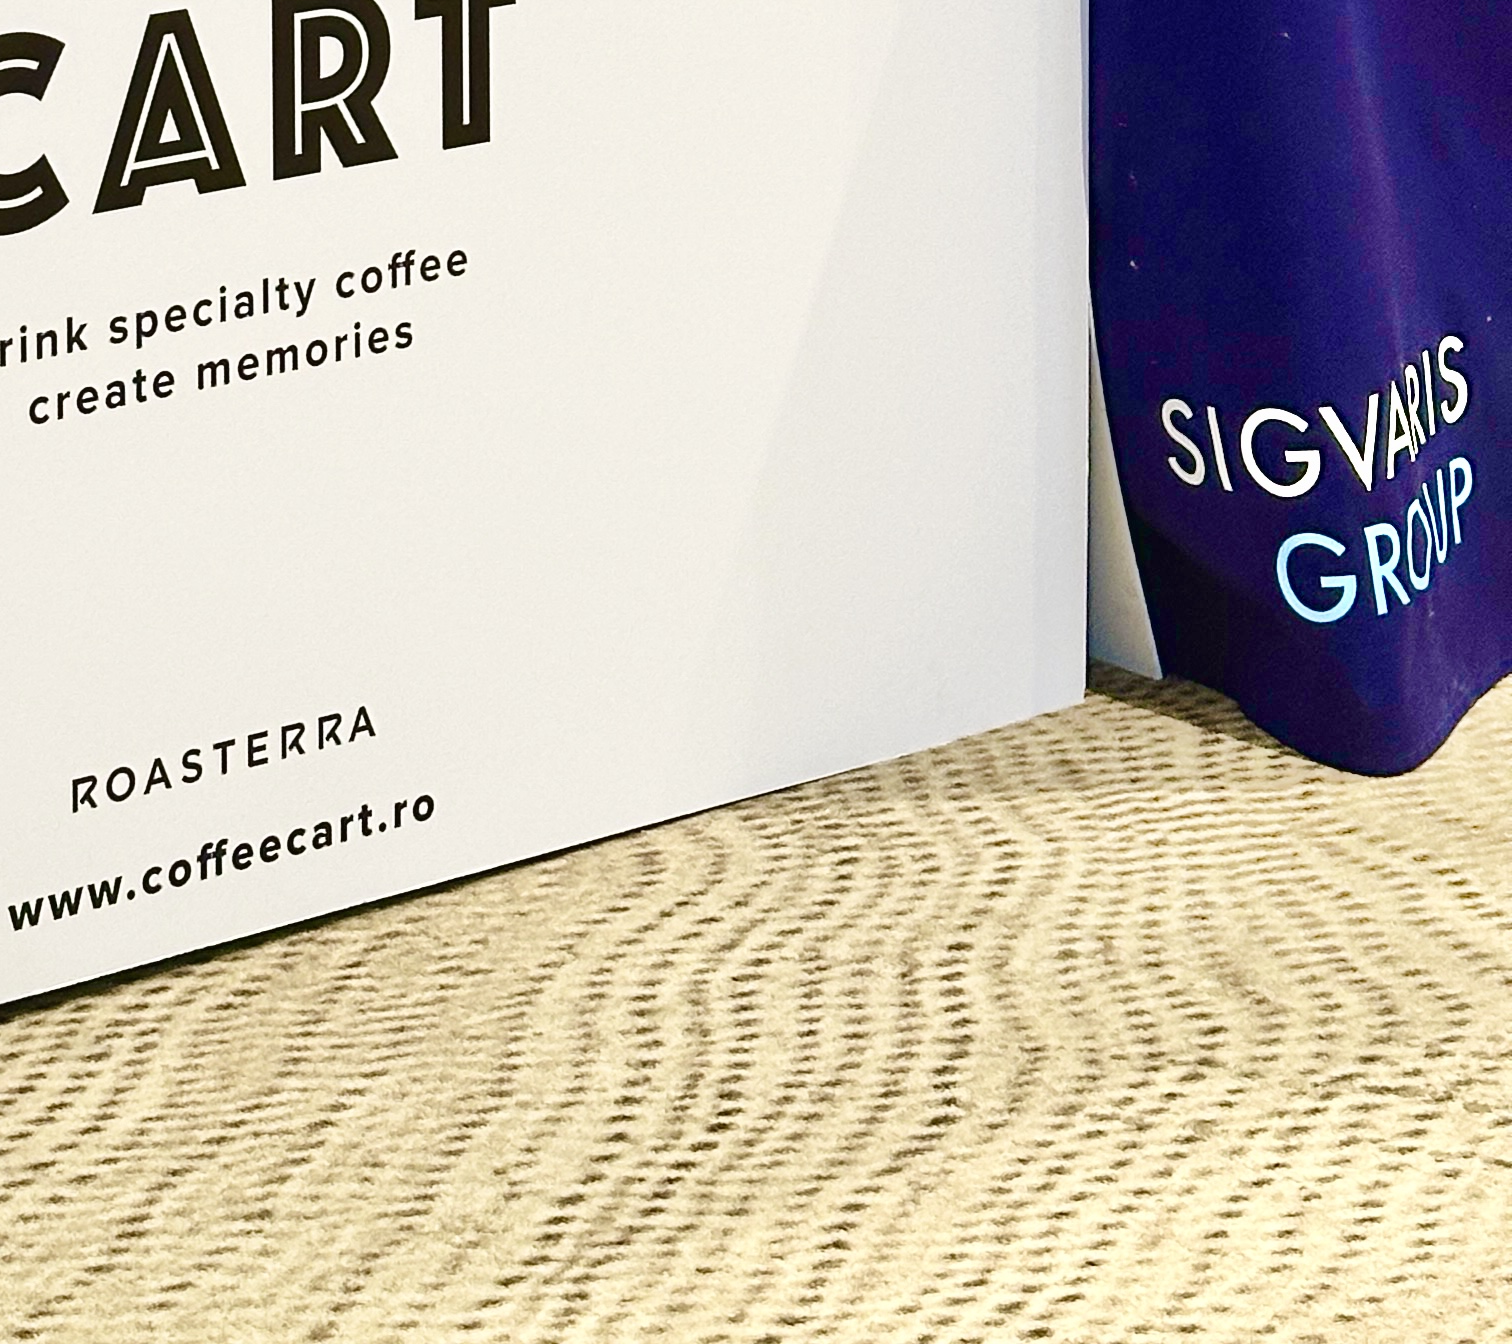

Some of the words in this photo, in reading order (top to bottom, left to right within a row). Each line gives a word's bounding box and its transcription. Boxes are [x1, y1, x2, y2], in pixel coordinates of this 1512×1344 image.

[108, 277, 317, 348] specialty
[335, 248, 469, 299] coffee
[29, 366, 175, 425] create
[197, 317, 415, 391] memories
[1161, 334, 1469, 498] SIGVARIS
[1276, 456, 1473, 624] GROUP
[71, 705, 377, 814] ROASTERRA
[7, 793, 436, 932] www.coffeecart.ro
